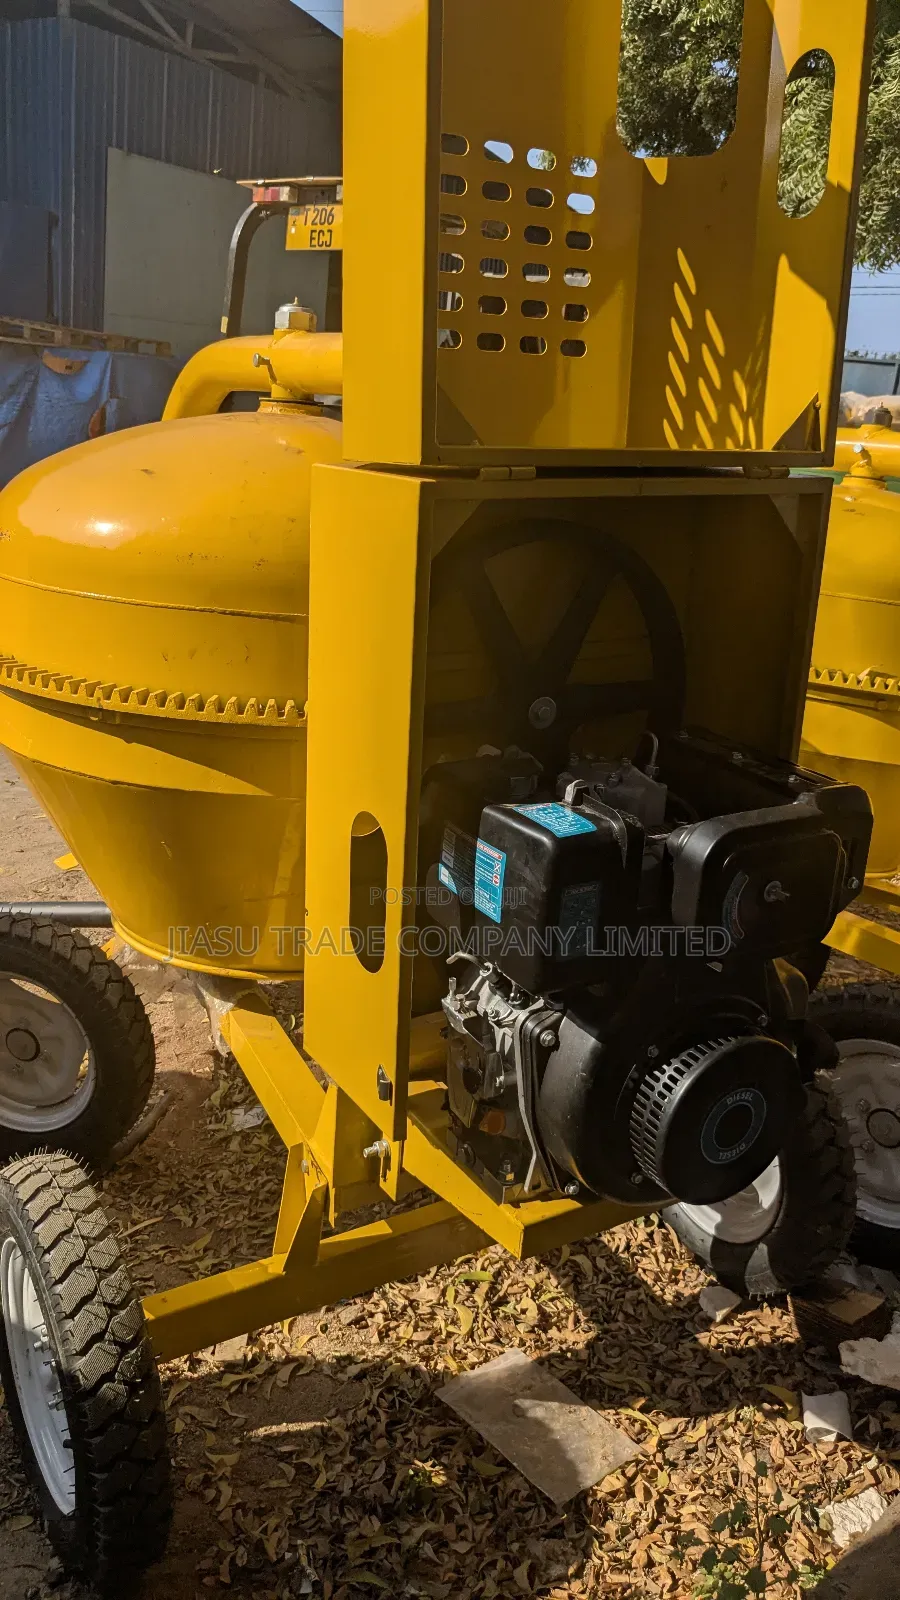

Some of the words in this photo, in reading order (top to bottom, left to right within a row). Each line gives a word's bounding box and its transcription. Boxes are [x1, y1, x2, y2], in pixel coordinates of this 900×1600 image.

[309, 229, 333, 248] ECJ
[726, 1091, 754, 1105] DIESEL
[718, 1142, 746, 1160] DIESEL
